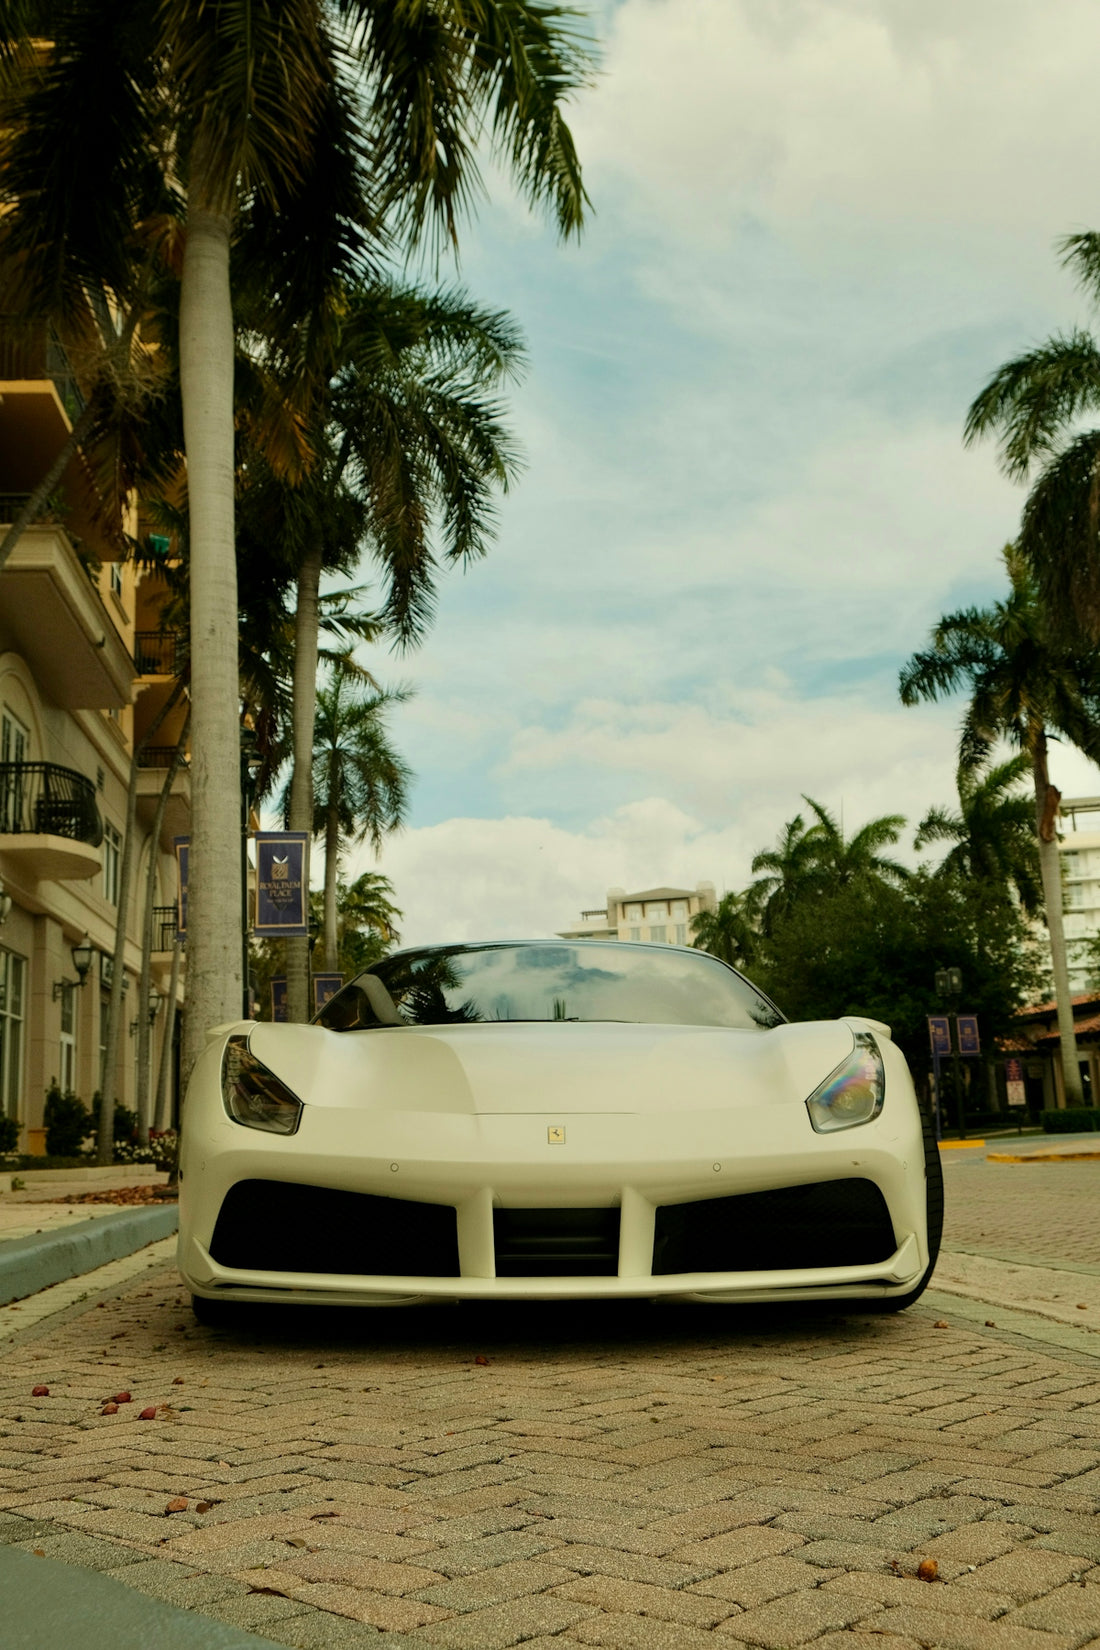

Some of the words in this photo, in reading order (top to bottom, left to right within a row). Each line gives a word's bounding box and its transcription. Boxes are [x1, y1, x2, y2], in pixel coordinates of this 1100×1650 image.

[260, 881, 280, 890] ROYAL
[281, 881, 301, 889] PALM
[269, 889, 292, 897] PLACE
